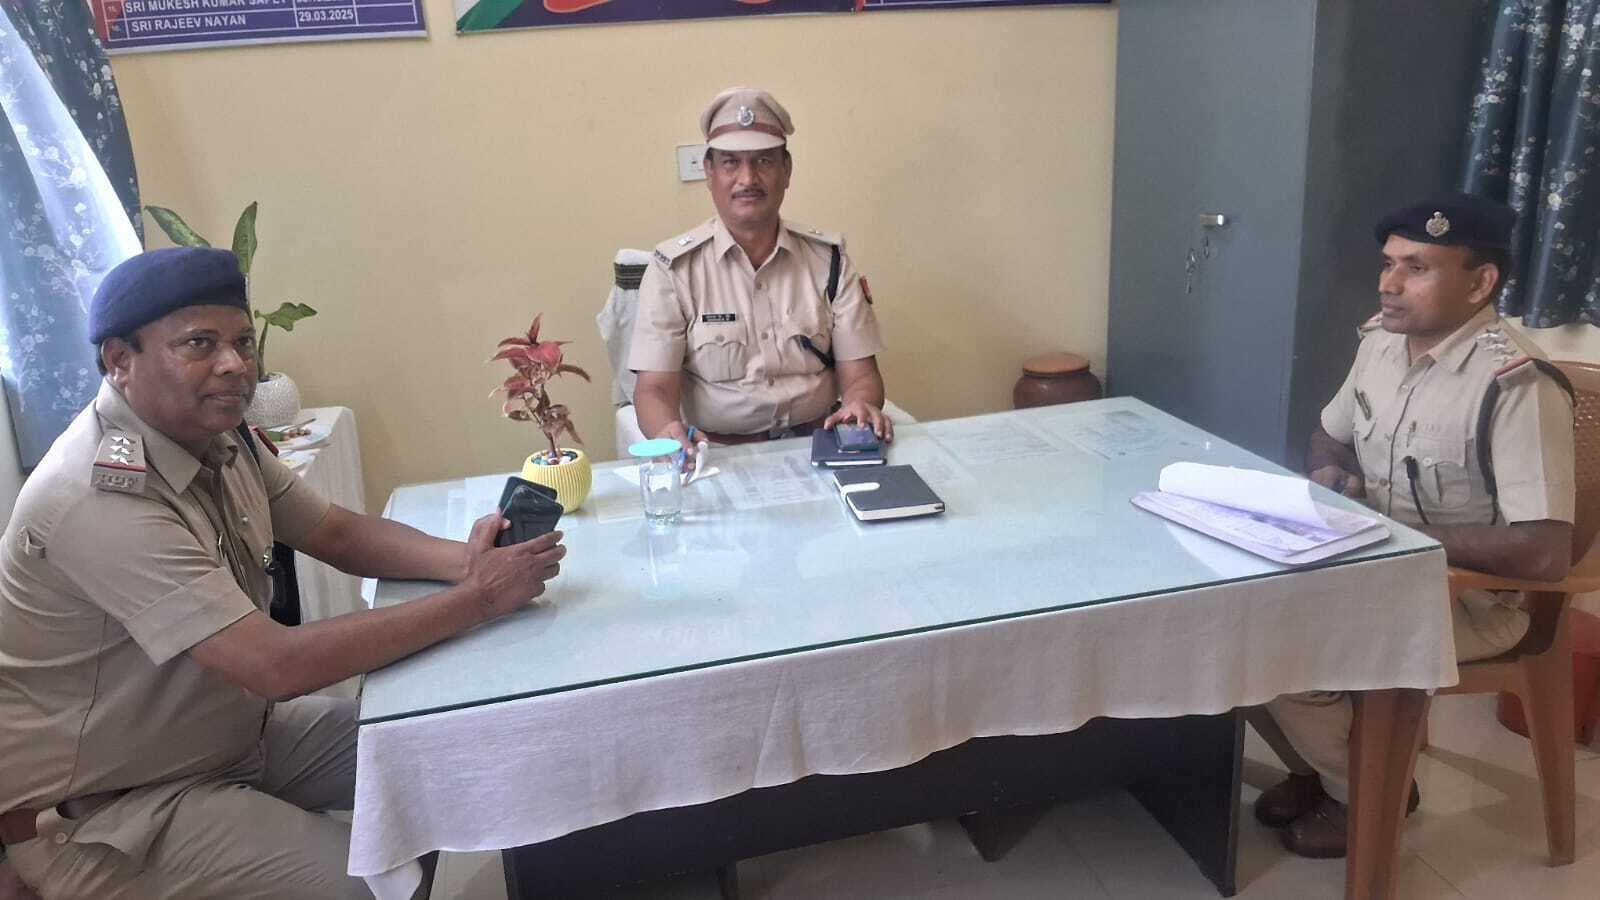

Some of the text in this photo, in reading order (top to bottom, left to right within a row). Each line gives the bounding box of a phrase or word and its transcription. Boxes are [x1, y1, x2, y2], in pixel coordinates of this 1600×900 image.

[125, 1, 146, 13] SRI
[149, 0, 199, 11] MUKESH
[298, 9, 354, 22] 29.03.2025
[131, 20, 152, 32] SRI
[154, 17, 201, 30] RAJEEV
[205, 14, 246, 27] NAYAN
